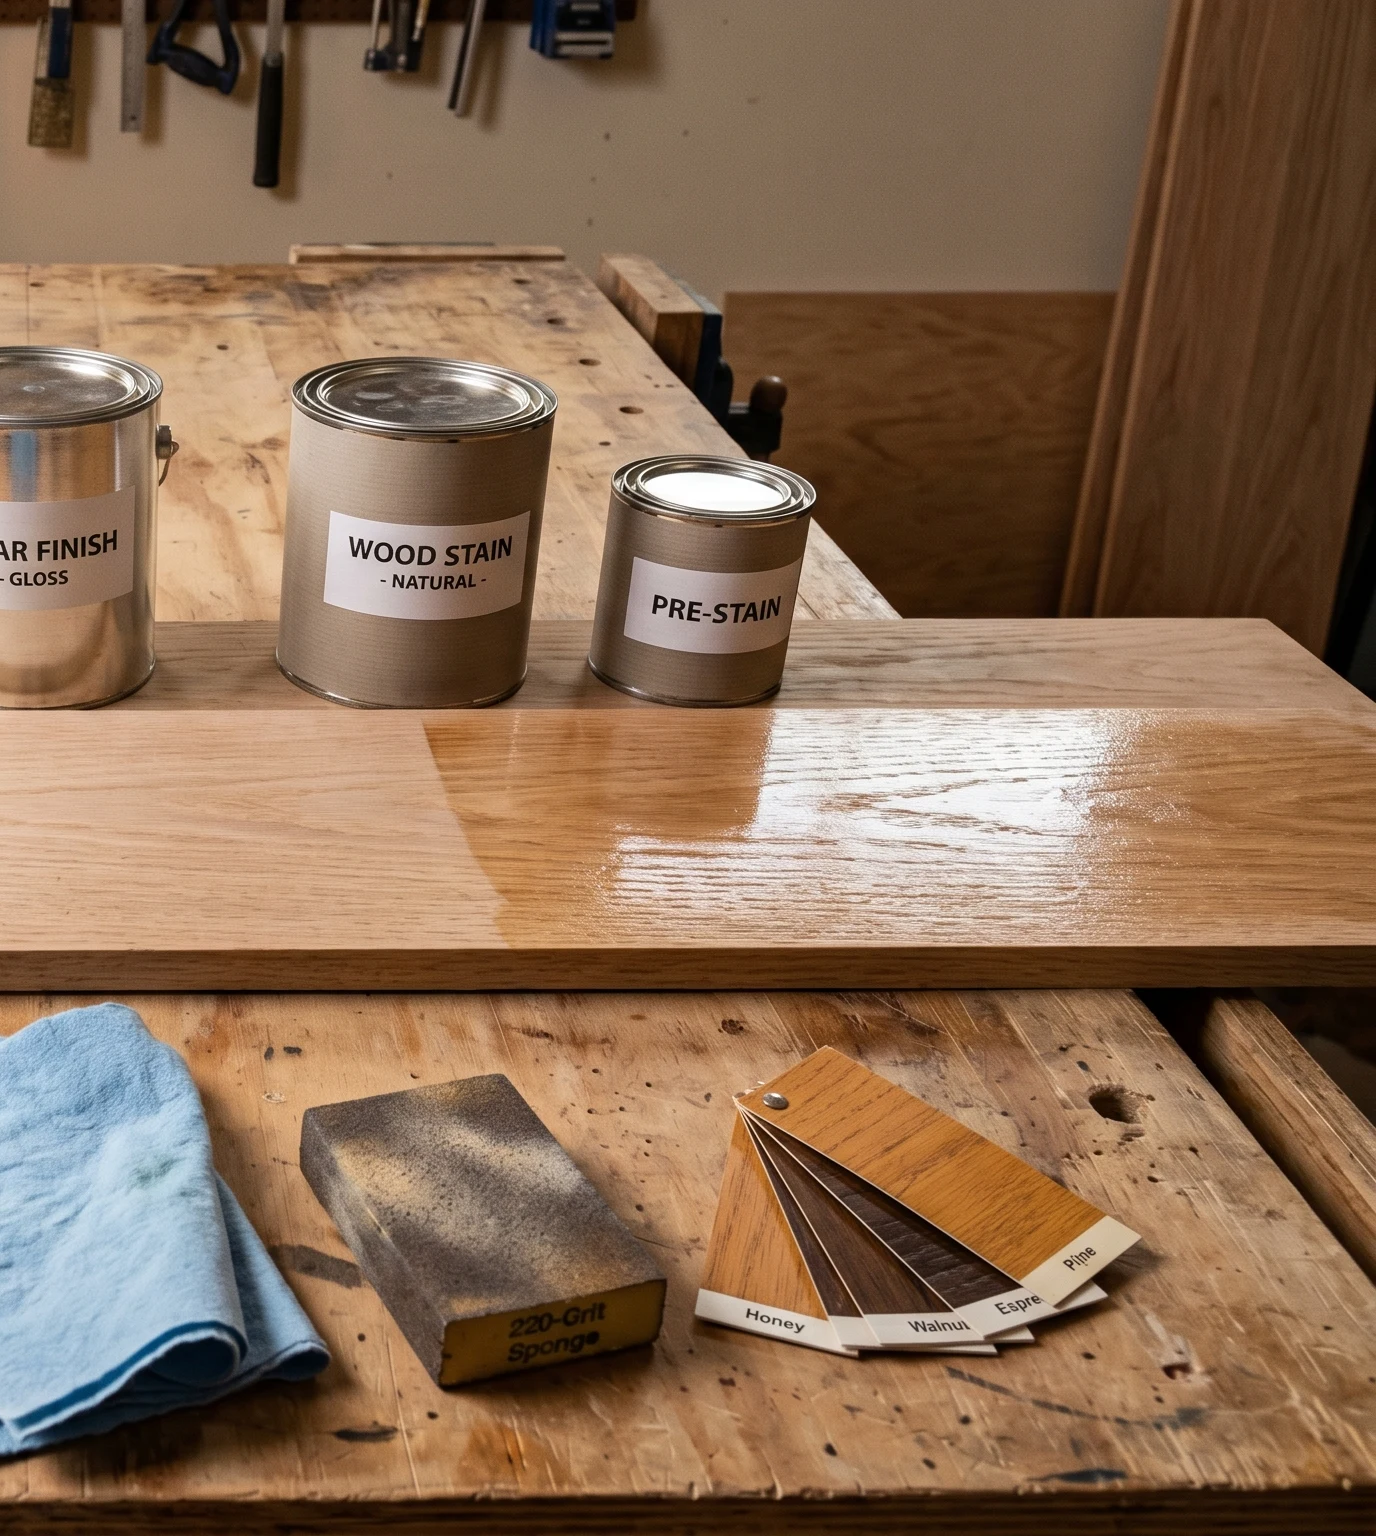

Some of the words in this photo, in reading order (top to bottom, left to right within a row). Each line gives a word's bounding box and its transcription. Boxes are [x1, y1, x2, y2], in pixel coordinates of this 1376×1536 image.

[37, 529, 118, 562] FINISH
[348, 535, 437, 566] WOOD
[444, 535, 513, 567] STAIN
[9, 570, 69, 587] GLOSS
[391, 573, 477, 590] NATURAL
[651, 594, 782, 624] PRE-STAIN
[508, 1302, 607, 1339] 220-Grit
[745, 1307, 806, 1334] Honey
